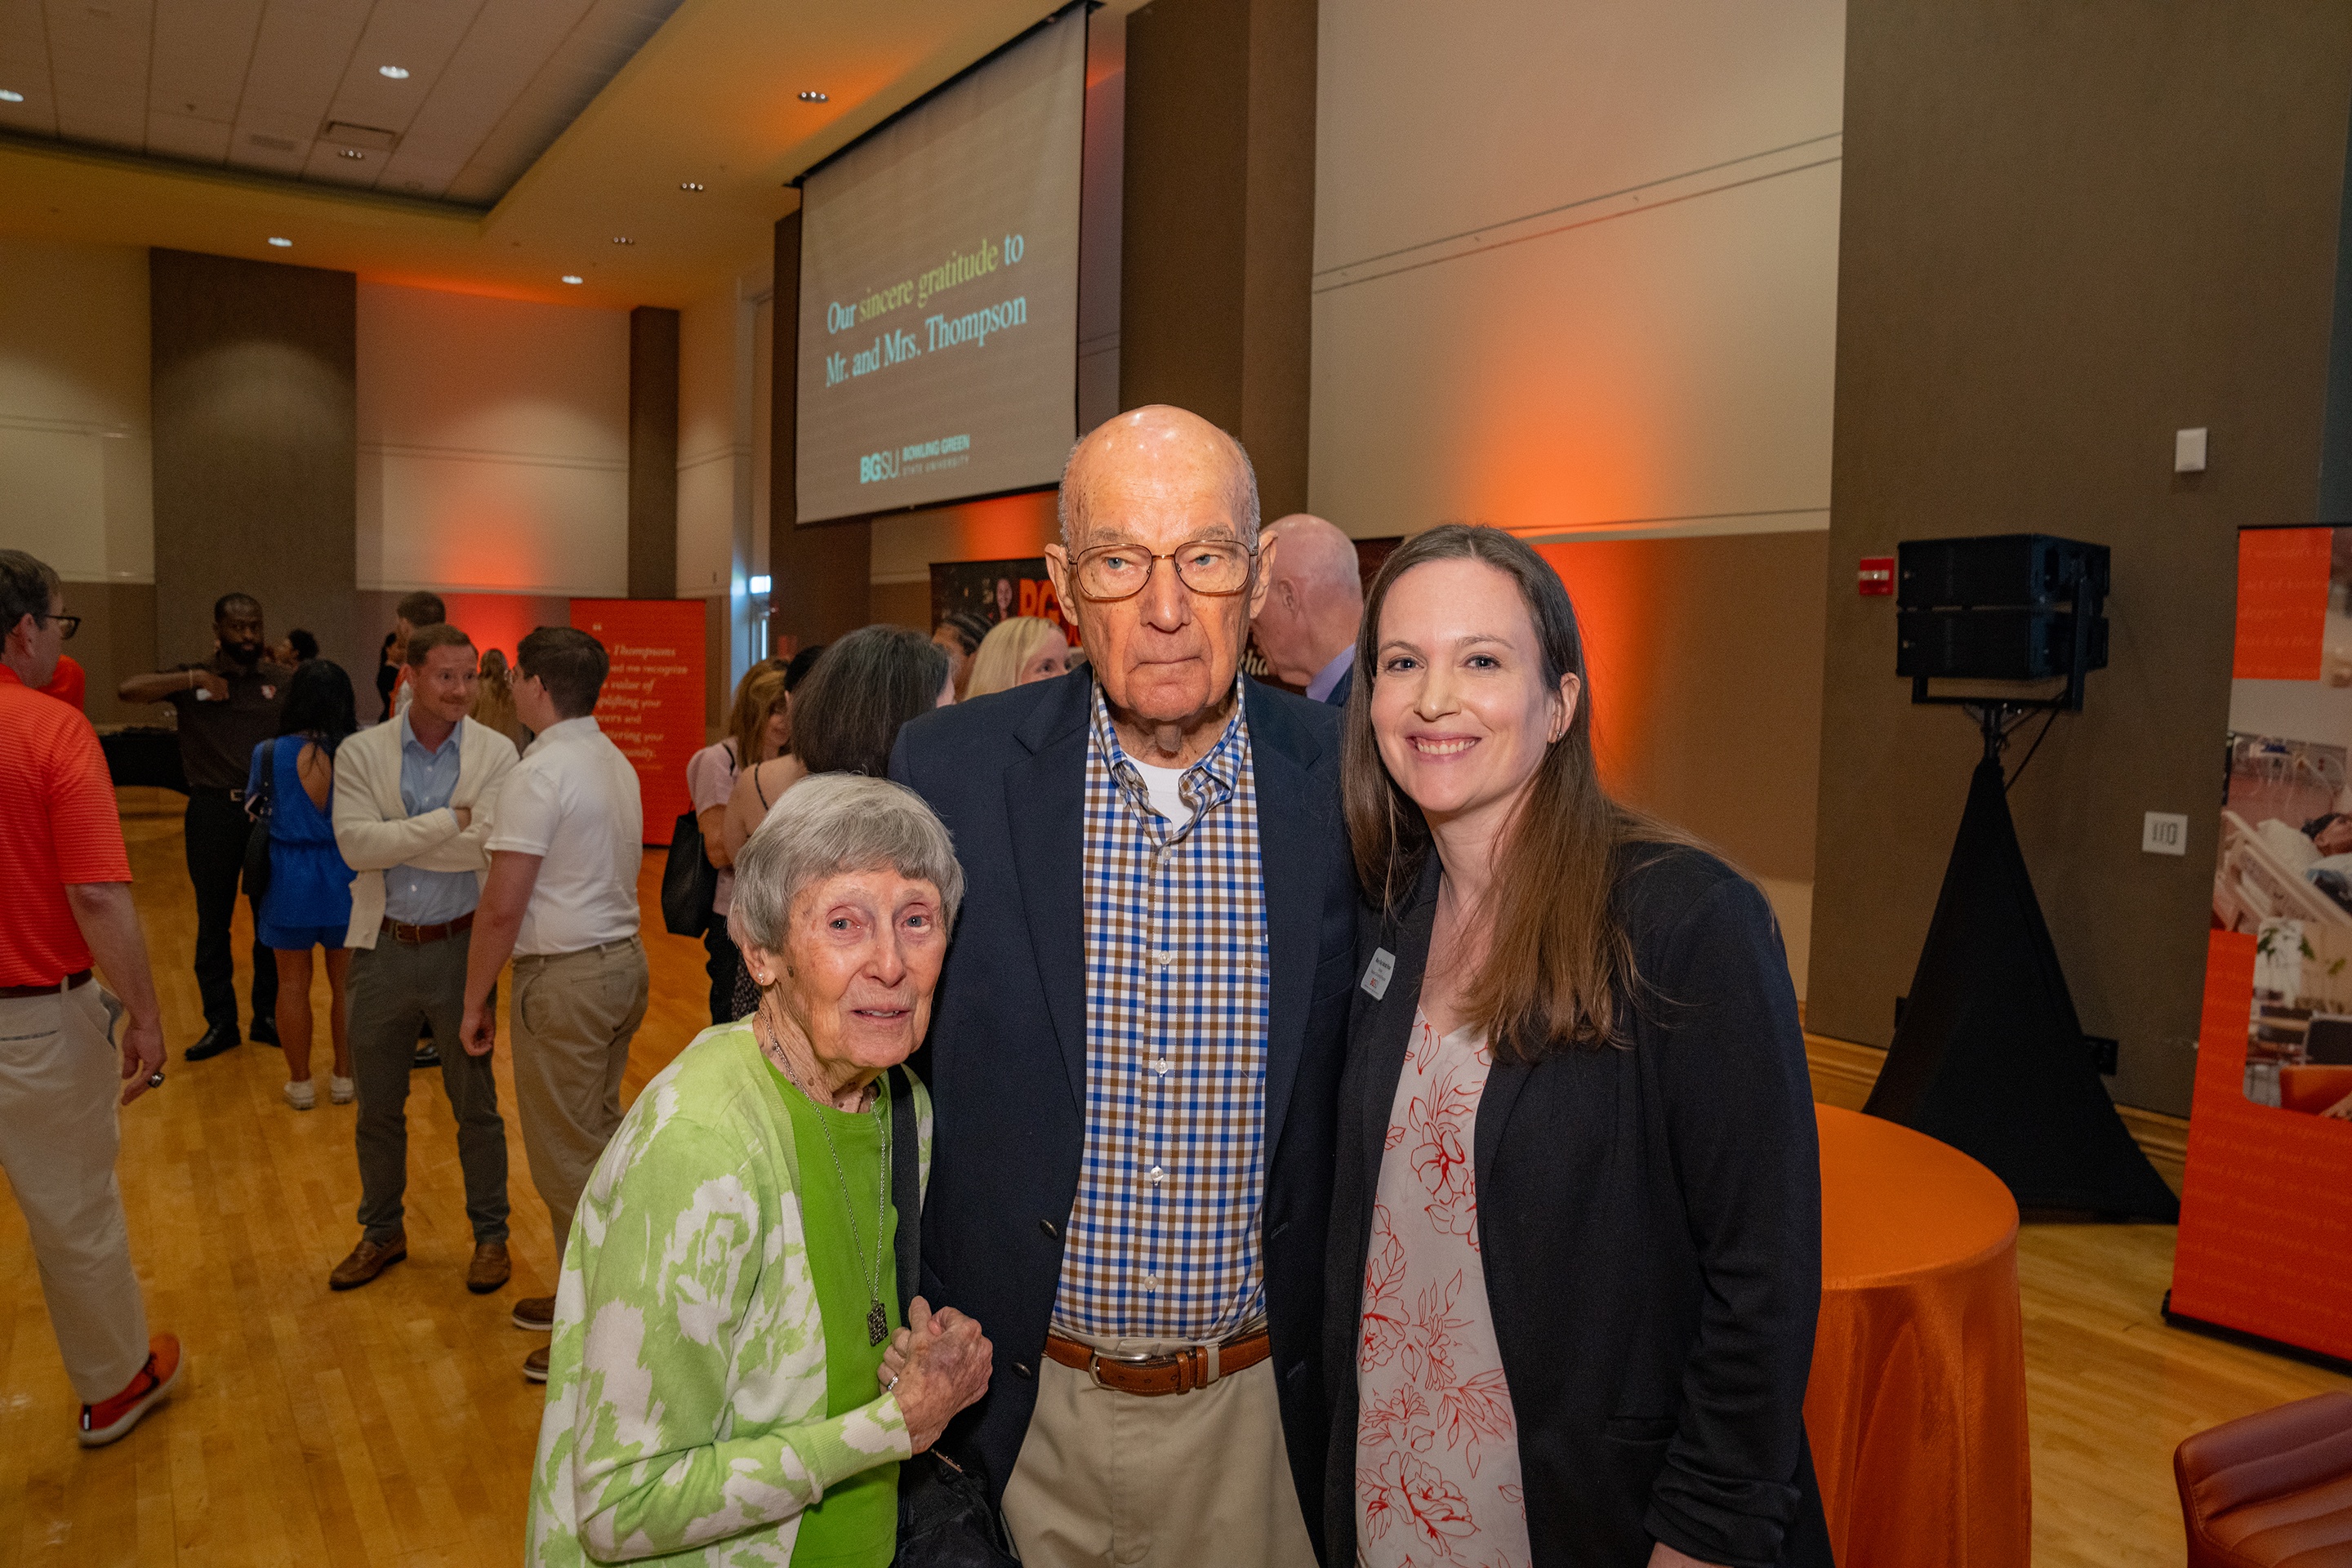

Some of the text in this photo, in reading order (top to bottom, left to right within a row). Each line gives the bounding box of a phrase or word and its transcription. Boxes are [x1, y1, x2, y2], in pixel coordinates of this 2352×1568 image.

[827, 234, 1024, 335] Our sincere gratitude to
[826, 296, 1027, 388] Mr. and Mrs. Thompson
[860, 450, 900, 484] BGSU
[902, 433, 970, 462] BOWLING GREEN
